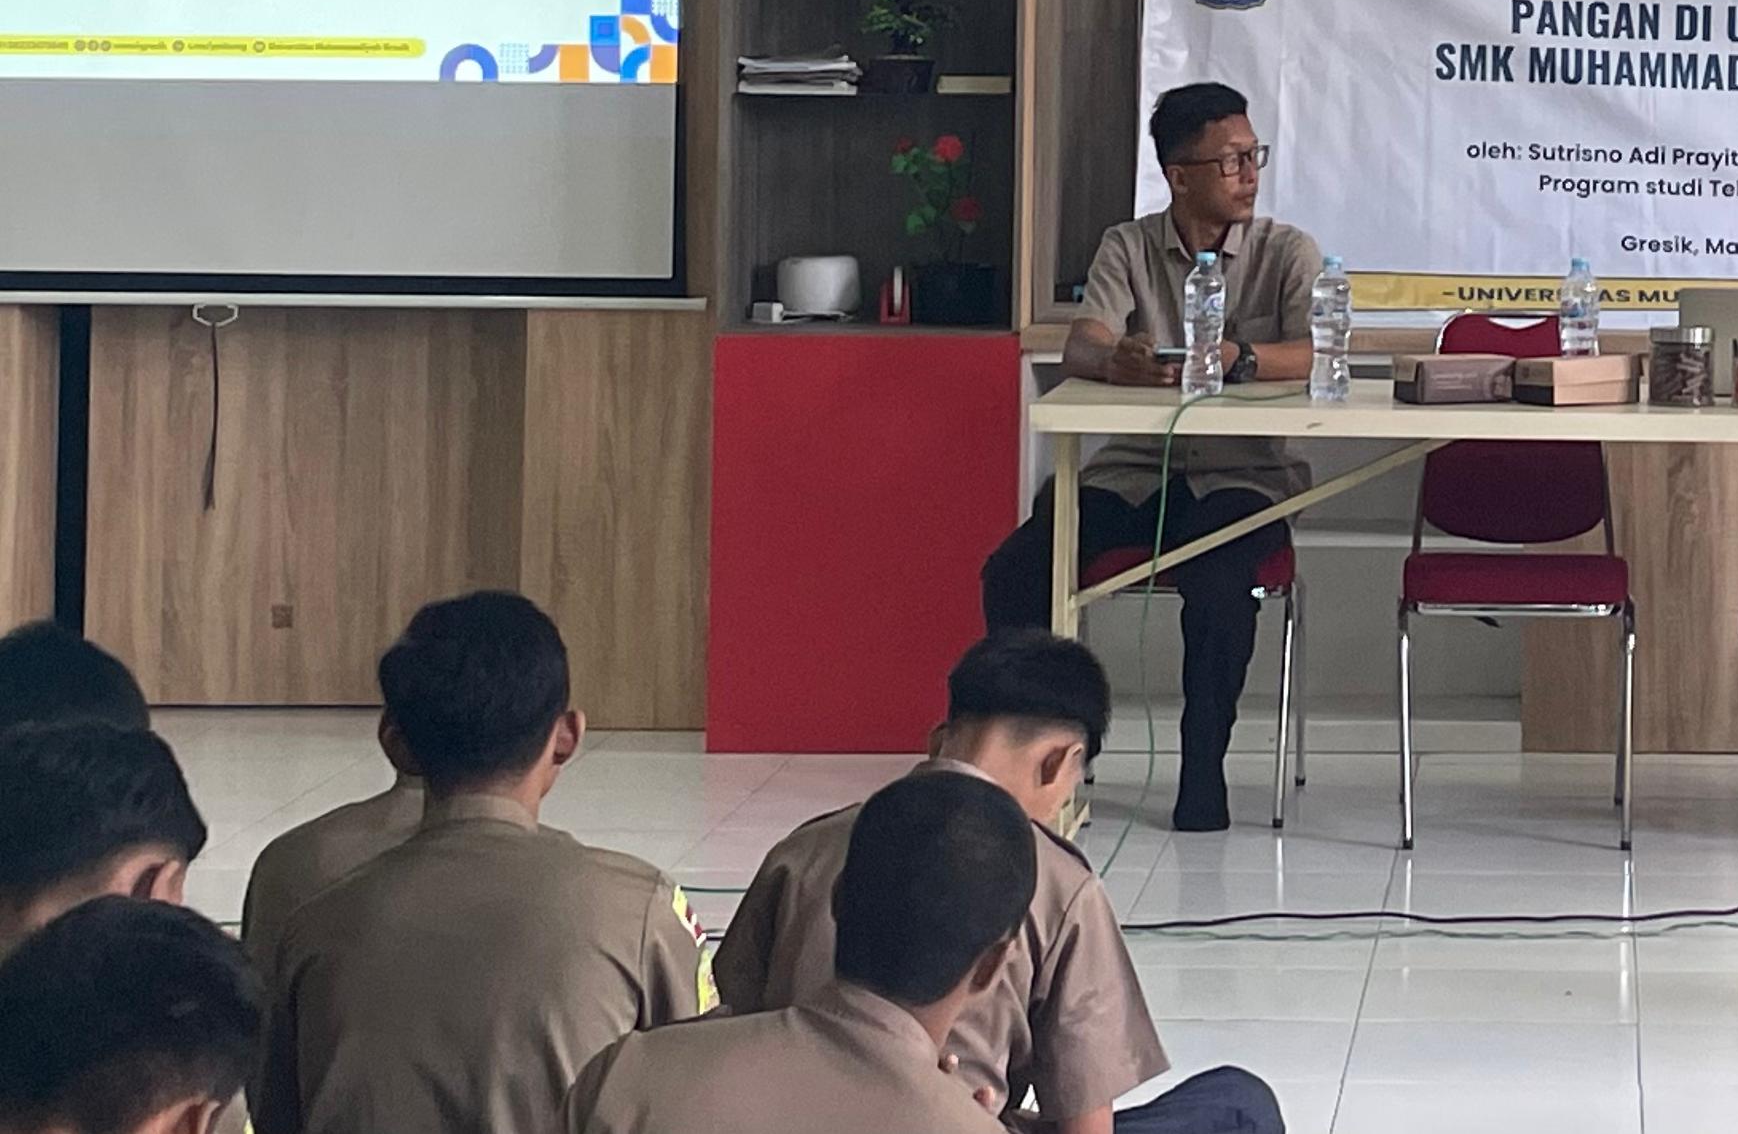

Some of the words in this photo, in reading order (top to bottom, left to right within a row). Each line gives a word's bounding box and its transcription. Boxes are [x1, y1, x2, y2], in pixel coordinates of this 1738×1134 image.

[1675, 3, 1712, 42] DI
[1435, 42, 1515, 83] SMK
[1466, 141, 1522, 160] oleh:
[1528, 143, 1623, 164] Sutrisno
[1628, 145, 1666, 166] Adi
[1539, 174, 1640, 199] Program
[1645, 177, 1703, 197] studi
[1620, 235, 1699, 257] Gresik,
